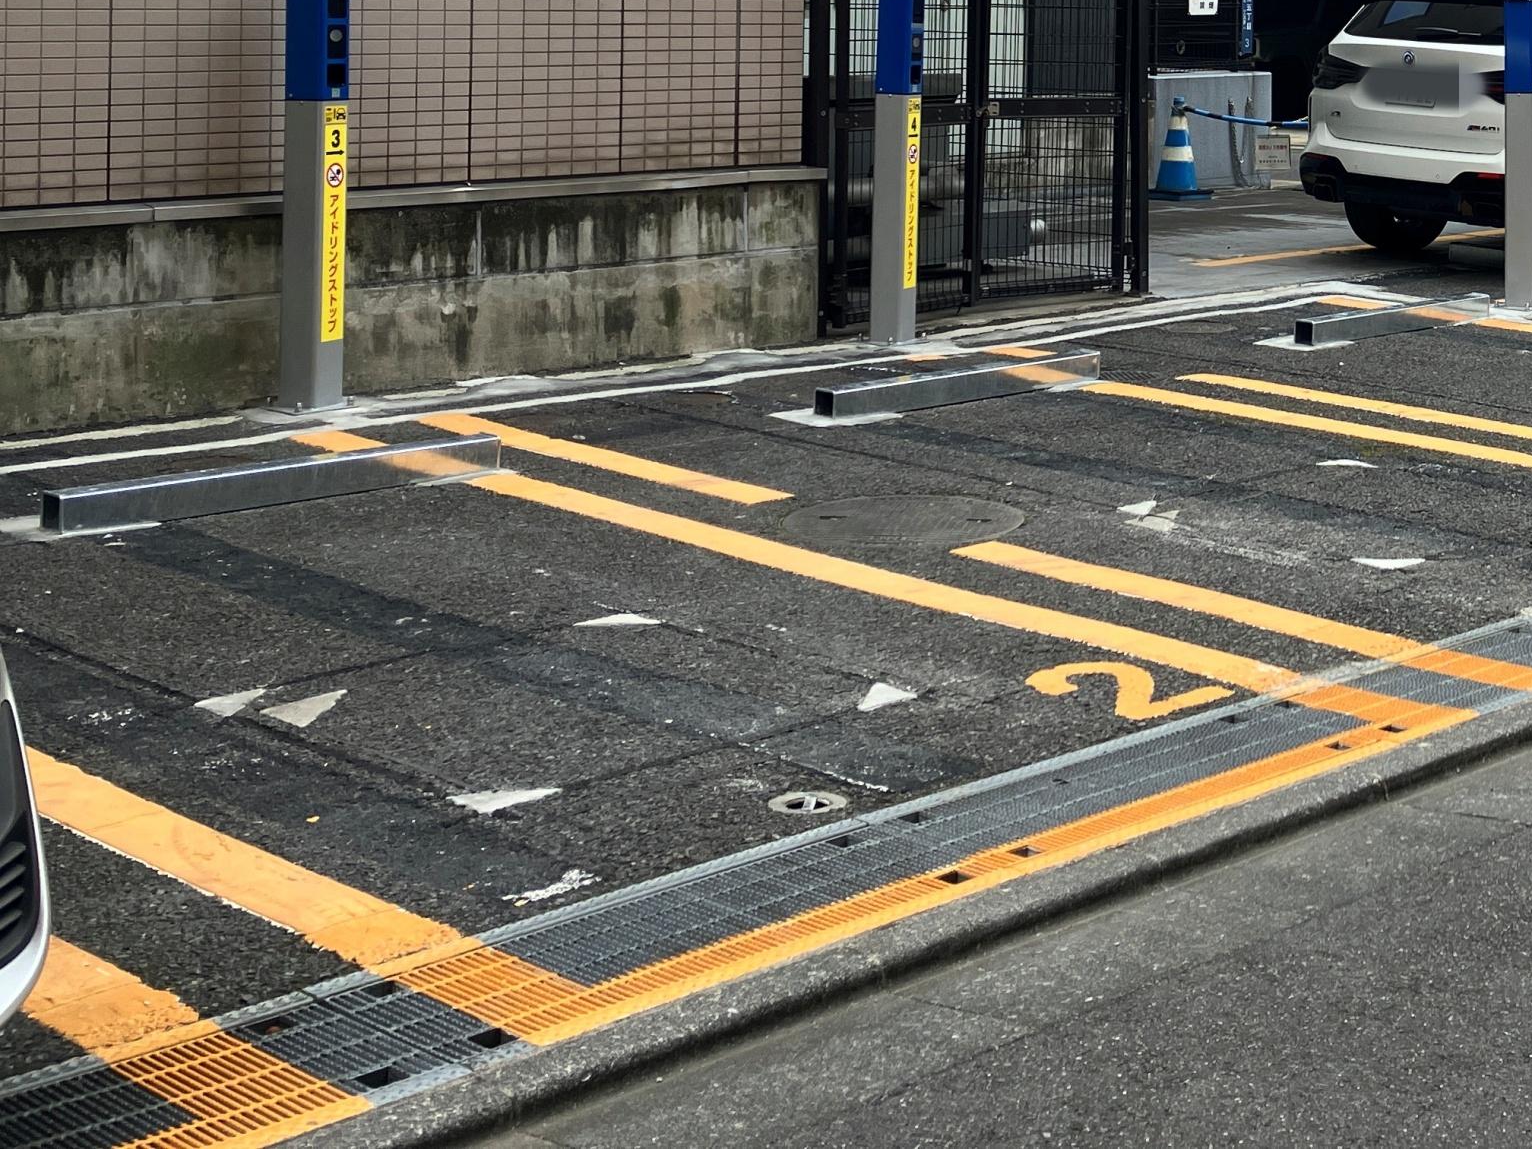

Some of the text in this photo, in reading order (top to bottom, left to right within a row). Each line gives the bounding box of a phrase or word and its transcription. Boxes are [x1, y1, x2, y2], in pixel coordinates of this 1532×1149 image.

[331, 130, 340, 148] 3
[911, 117, 917, 131] 4
[907, 169, 915, 282] アイドリングストップ
[328, 194, 339, 333] アイドリングストップ
[1025, 660, 1235, 721] 2
